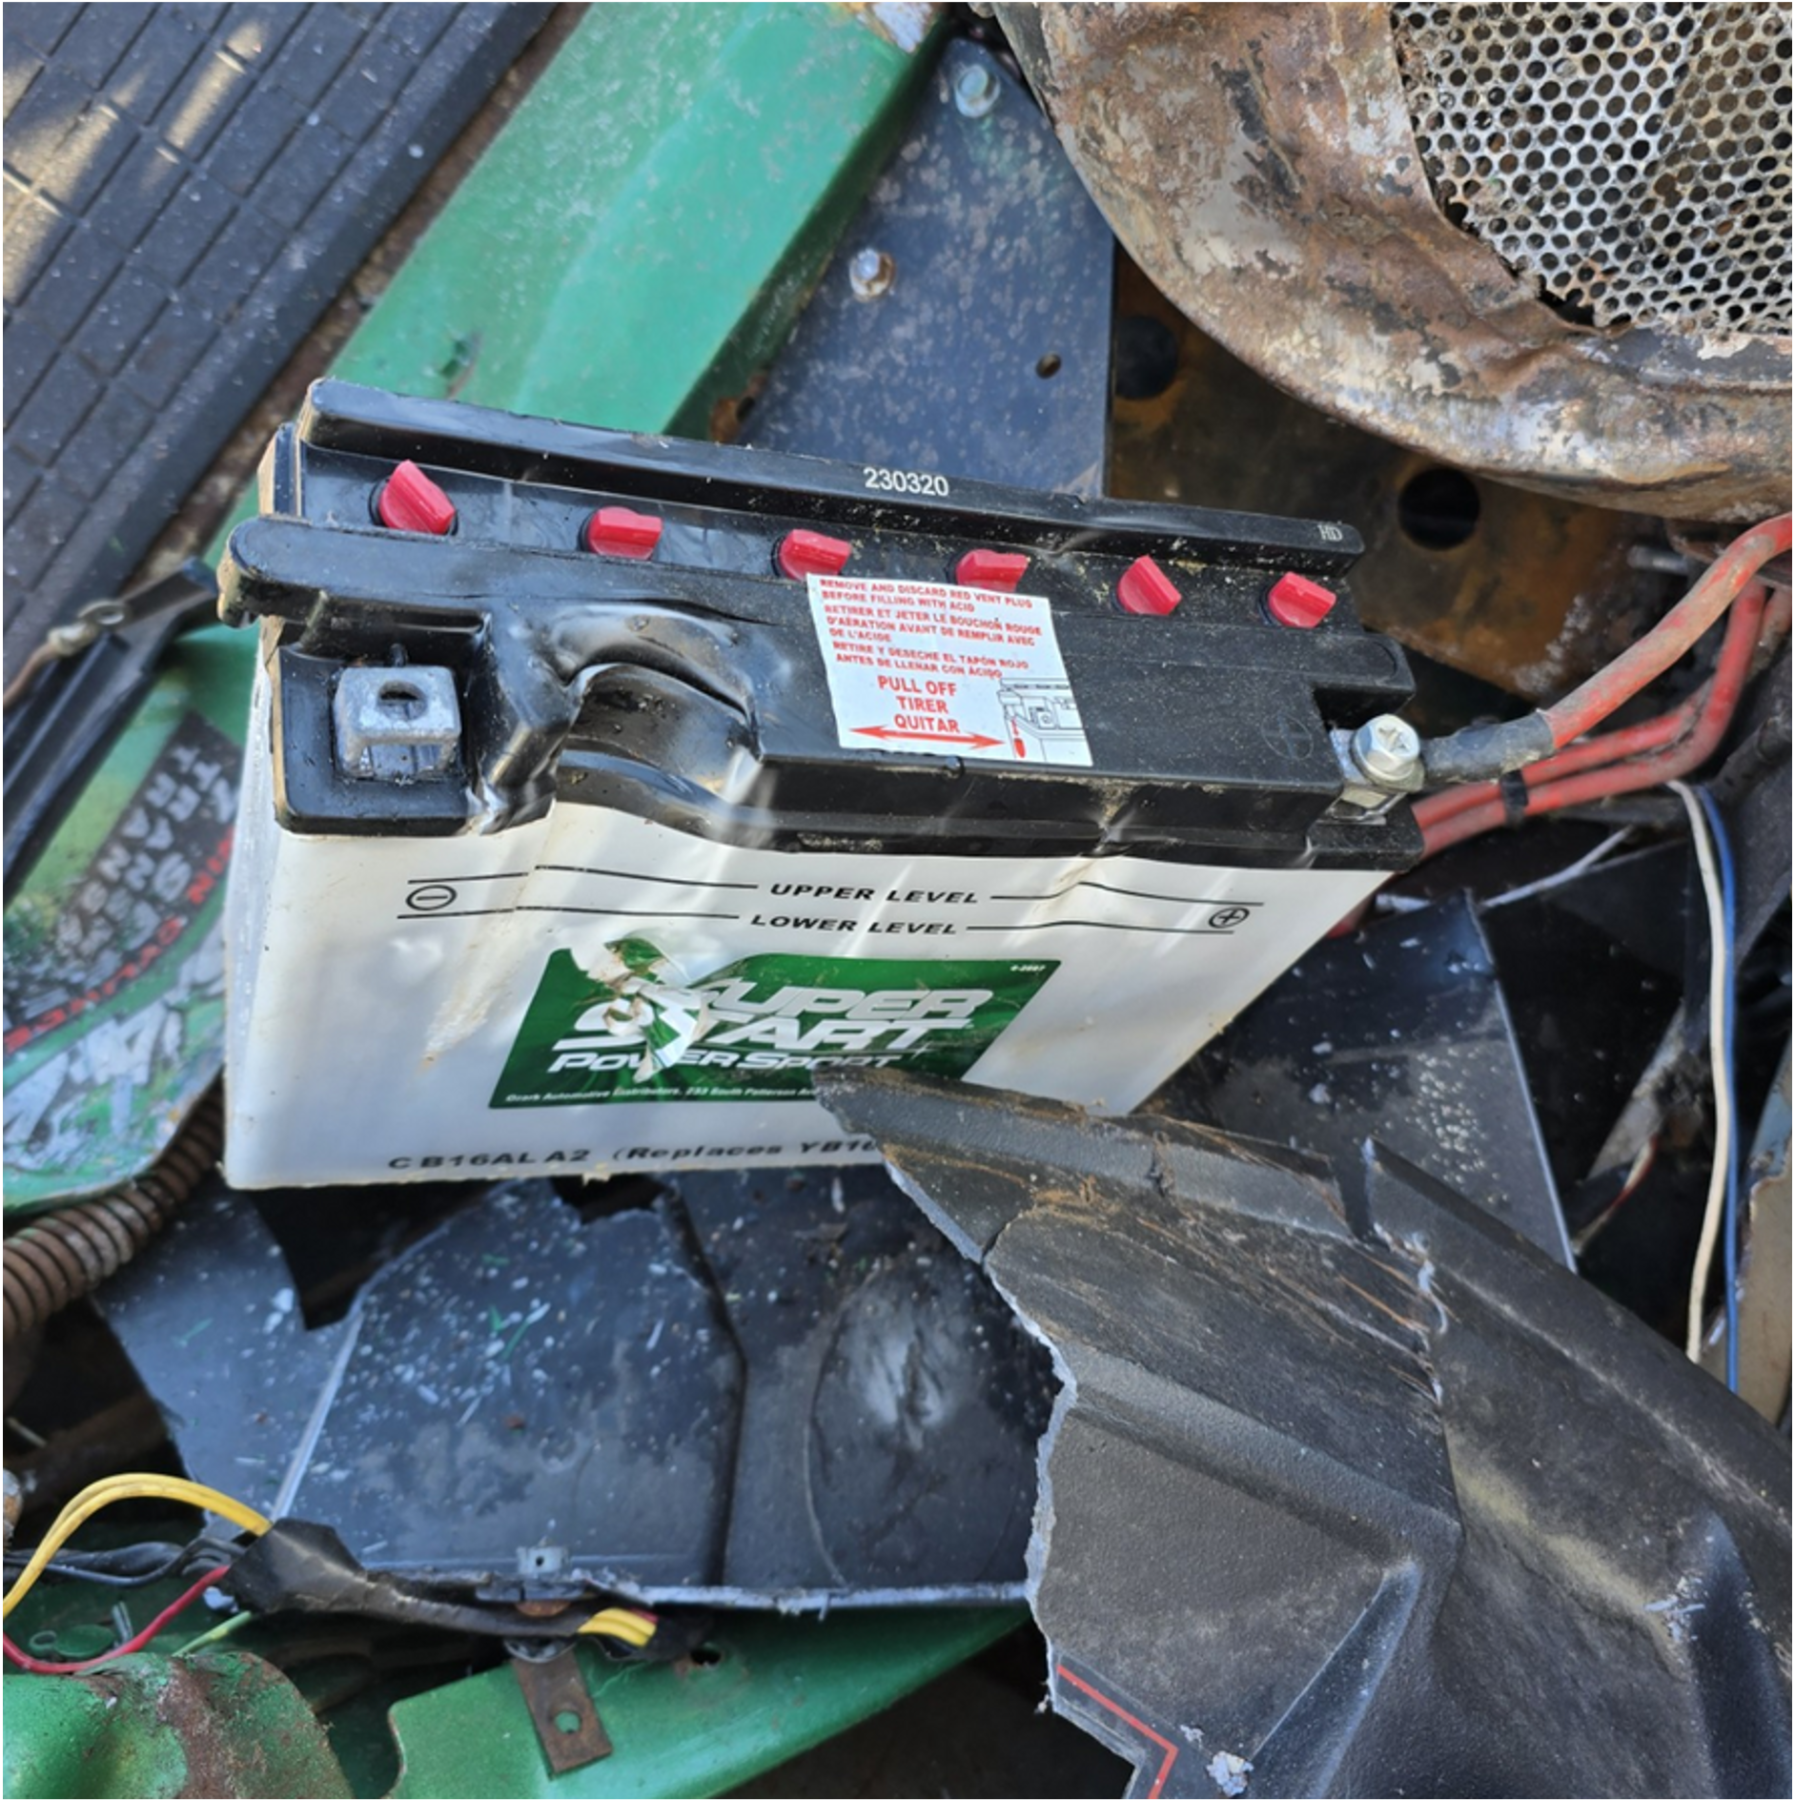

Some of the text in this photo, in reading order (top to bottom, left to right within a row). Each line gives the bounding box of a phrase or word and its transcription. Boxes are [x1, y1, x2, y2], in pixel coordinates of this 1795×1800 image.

[863, 466, 950, 497] 230320
[820, 579, 867, 591] REMOVE
[871, 583, 895, 593] AND
[897, 584, 947, 598] DISCARD
[949, 589, 972, 600] RED
[974, 592, 1002, 605] VENT
[822, 591, 976, 613] BEFORE FILLING WITH ACID
[824, 604, 1043, 636] RETIRER ET JETER LE BOUCHON ROUGE
[828, 628, 892, 643] DE L'ACIDE
[899, 623, 937, 635] AVANT
[940, 626, 955, 637] DE
[957, 629, 1004, 644] REMPLIR
[1007, 636, 1036, 648] AVEC
[832, 641, 874, 653] RETIRE
[877, 646, 885, 655] Y
[942, 652, 957, 664] EL
[999, 659, 1030, 671] ROJO
[836, 653, 875, 666] ANTES
[876, 658, 893, 668] DE
[895, 661, 940, 674] LLENAR
[941, 665, 966, 676] CON
[877, 674, 957, 697] PULL OFF
[896, 695, 949, 714] TIRER
[893, 713, 960, 734] QUITAR
[769, 882, 979, 905] UPPER LEVEL
[749, 914, 958, 936] LOWER LEVEL
[690, 976, 994, 1019] UPER
[612, 1143, 784, 1163] (Replaces
